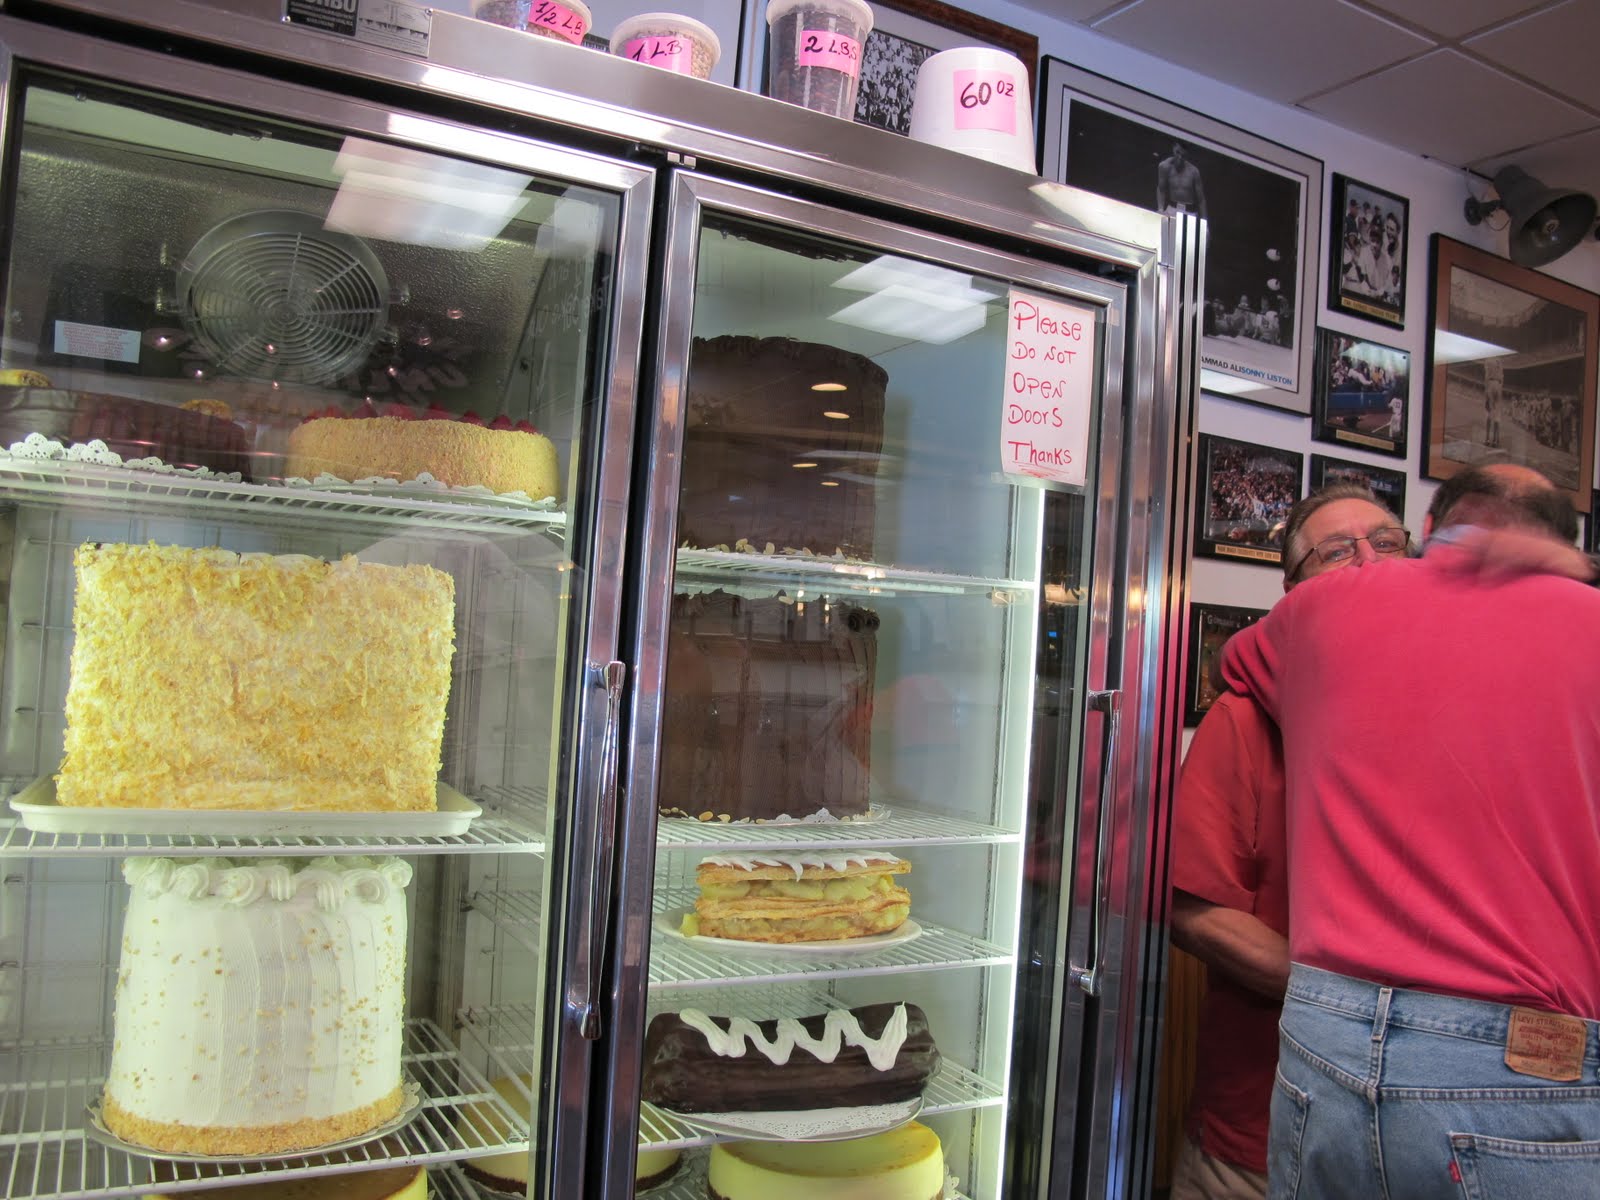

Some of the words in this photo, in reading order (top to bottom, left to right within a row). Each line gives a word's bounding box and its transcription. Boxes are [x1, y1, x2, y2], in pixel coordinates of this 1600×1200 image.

[535, 1, 557, 24] 1/2
[632, 42, 646, 61] 1
[805, 35, 823, 53] 2
[960, 82, 992, 109] 60
[1013, 301, 1082, 341] Please
[1011, 341, 1036, 359] Do
[1266, 372, 1293, 385] LISTON
